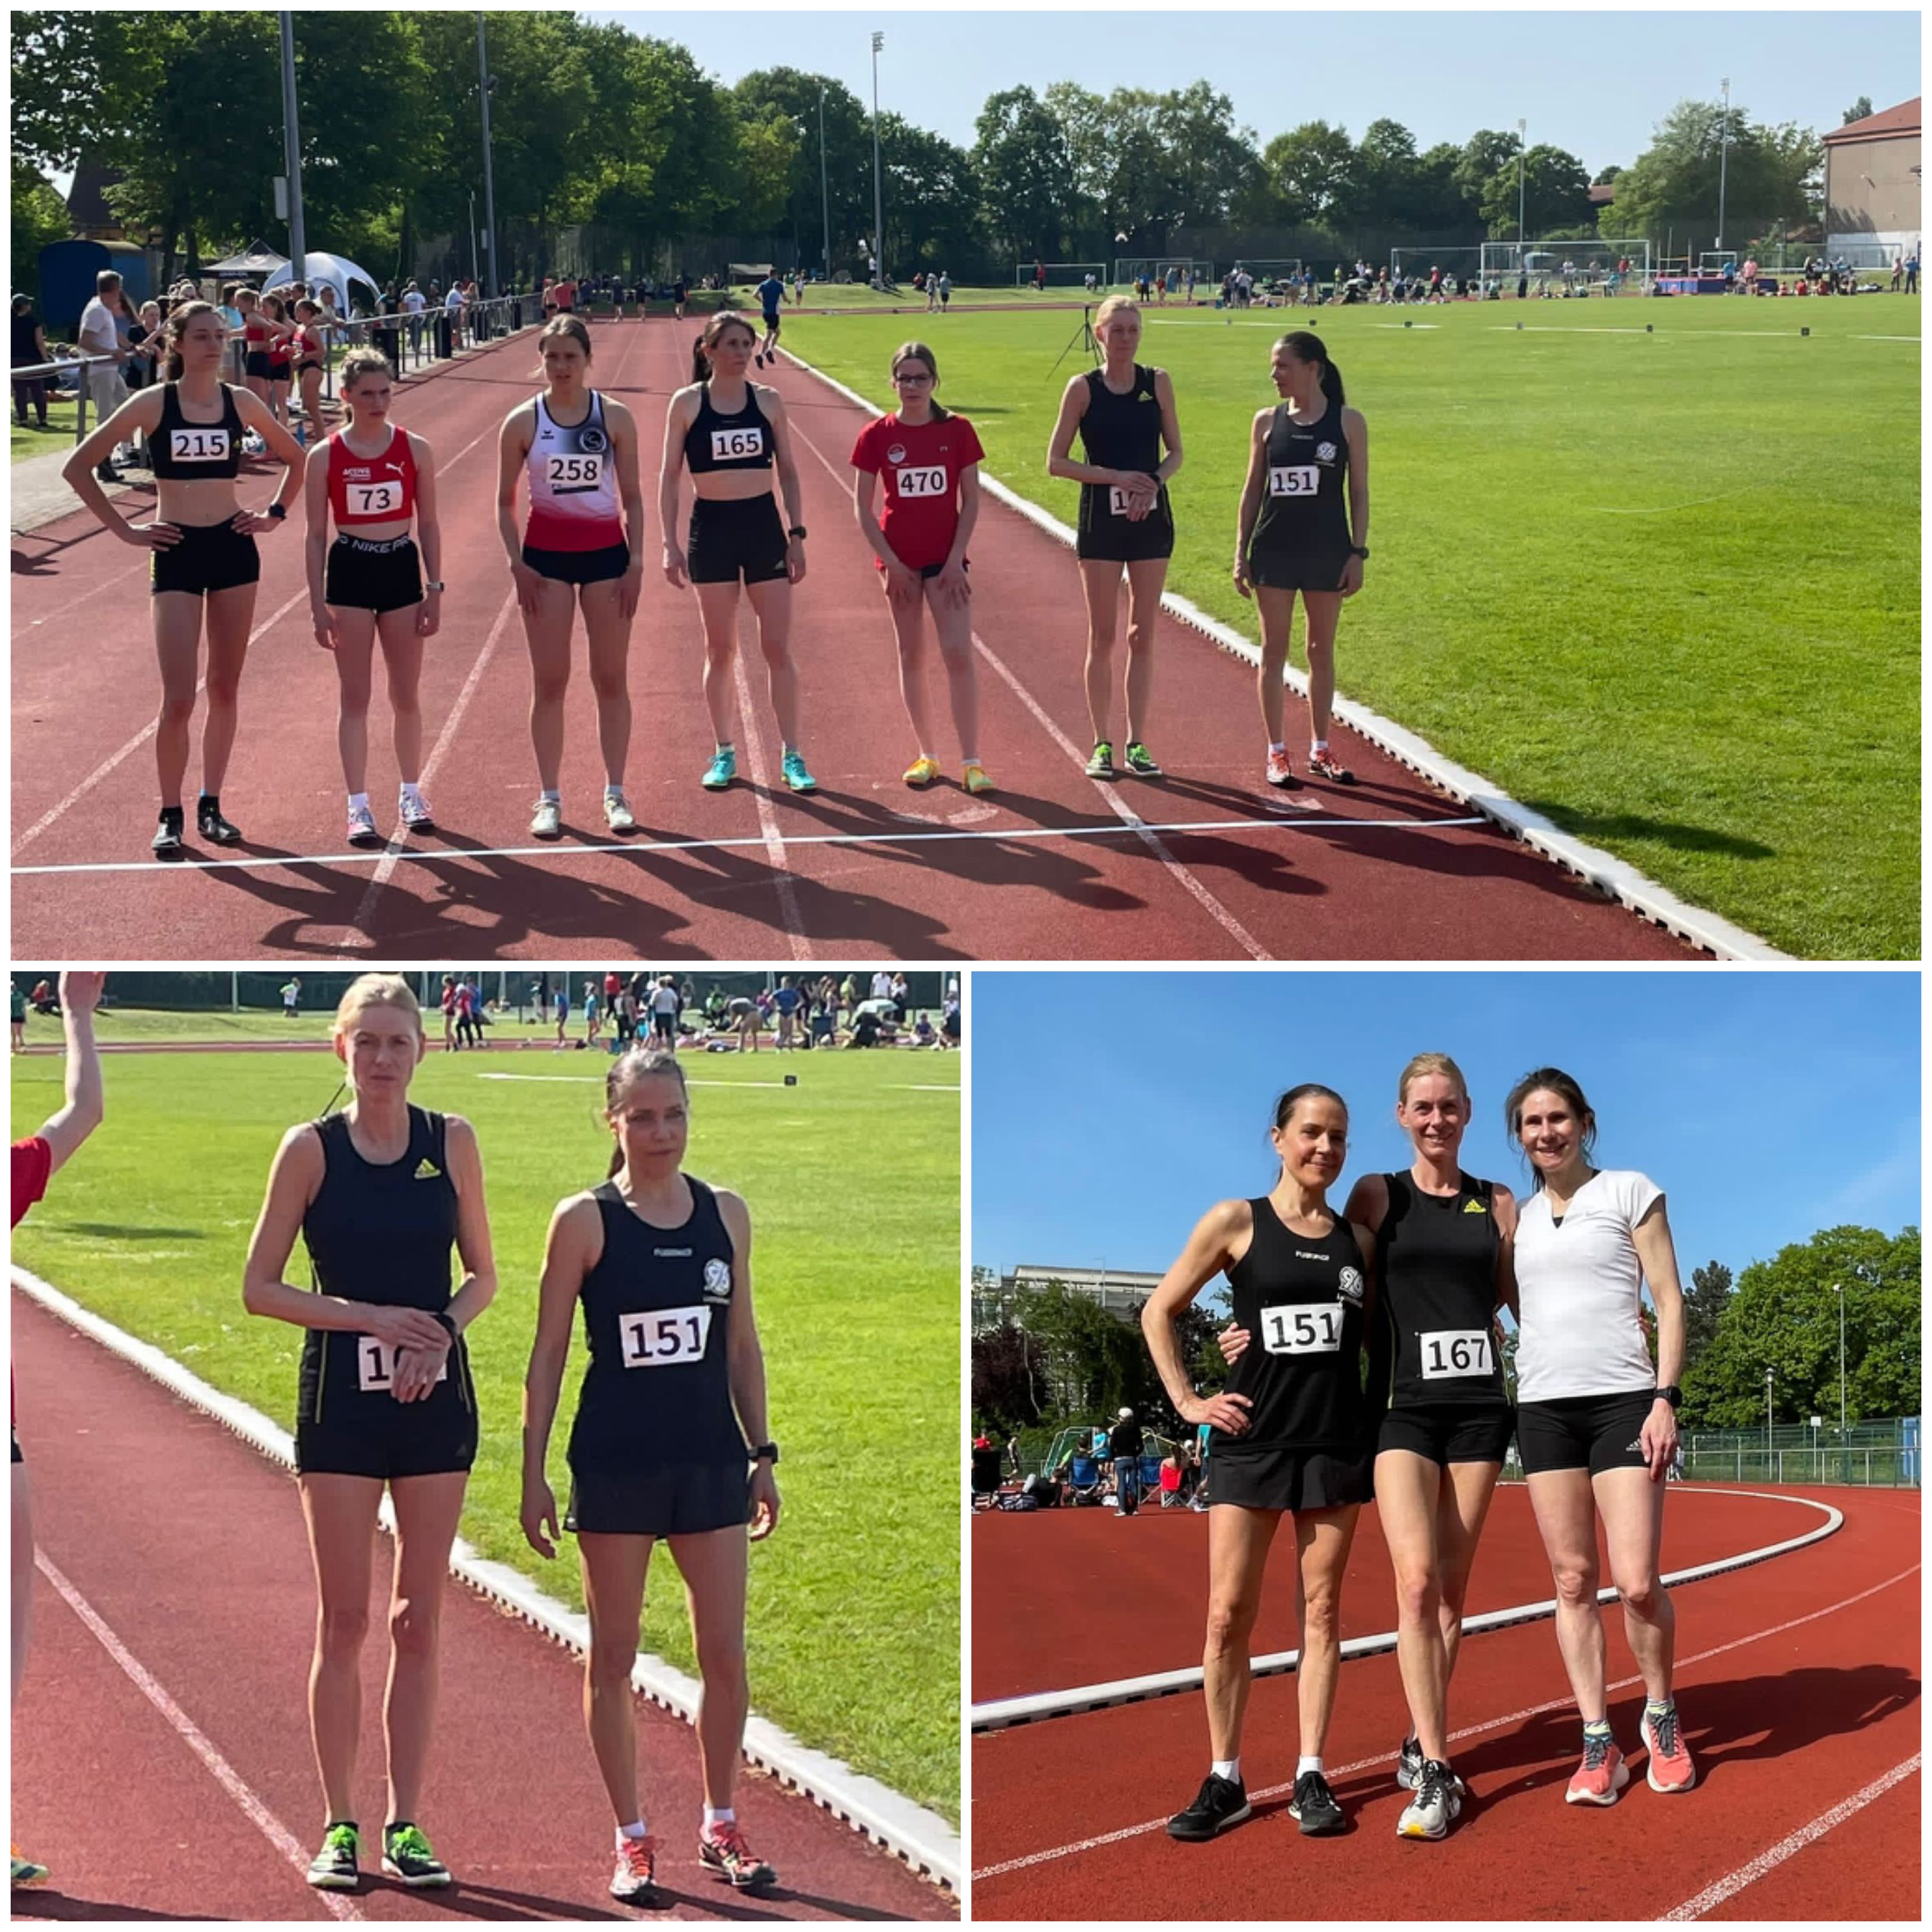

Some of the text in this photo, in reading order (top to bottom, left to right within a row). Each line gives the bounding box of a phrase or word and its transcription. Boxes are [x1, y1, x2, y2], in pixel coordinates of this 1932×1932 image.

[175, 435, 224, 456] 215
[716, 433, 759, 456] 165
[550, 459, 598, 481] 258
[1274, 470, 1314, 492] 151
[901, 471, 944, 492] 470
[358, 489, 390, 510] 73
[352, 539, 390, 553] NIKE
[629, 1316, 702, 1359] 151
[1270, 1312, 1338, 1349] 151
[1428, 1339, 1484, 1371] 167
